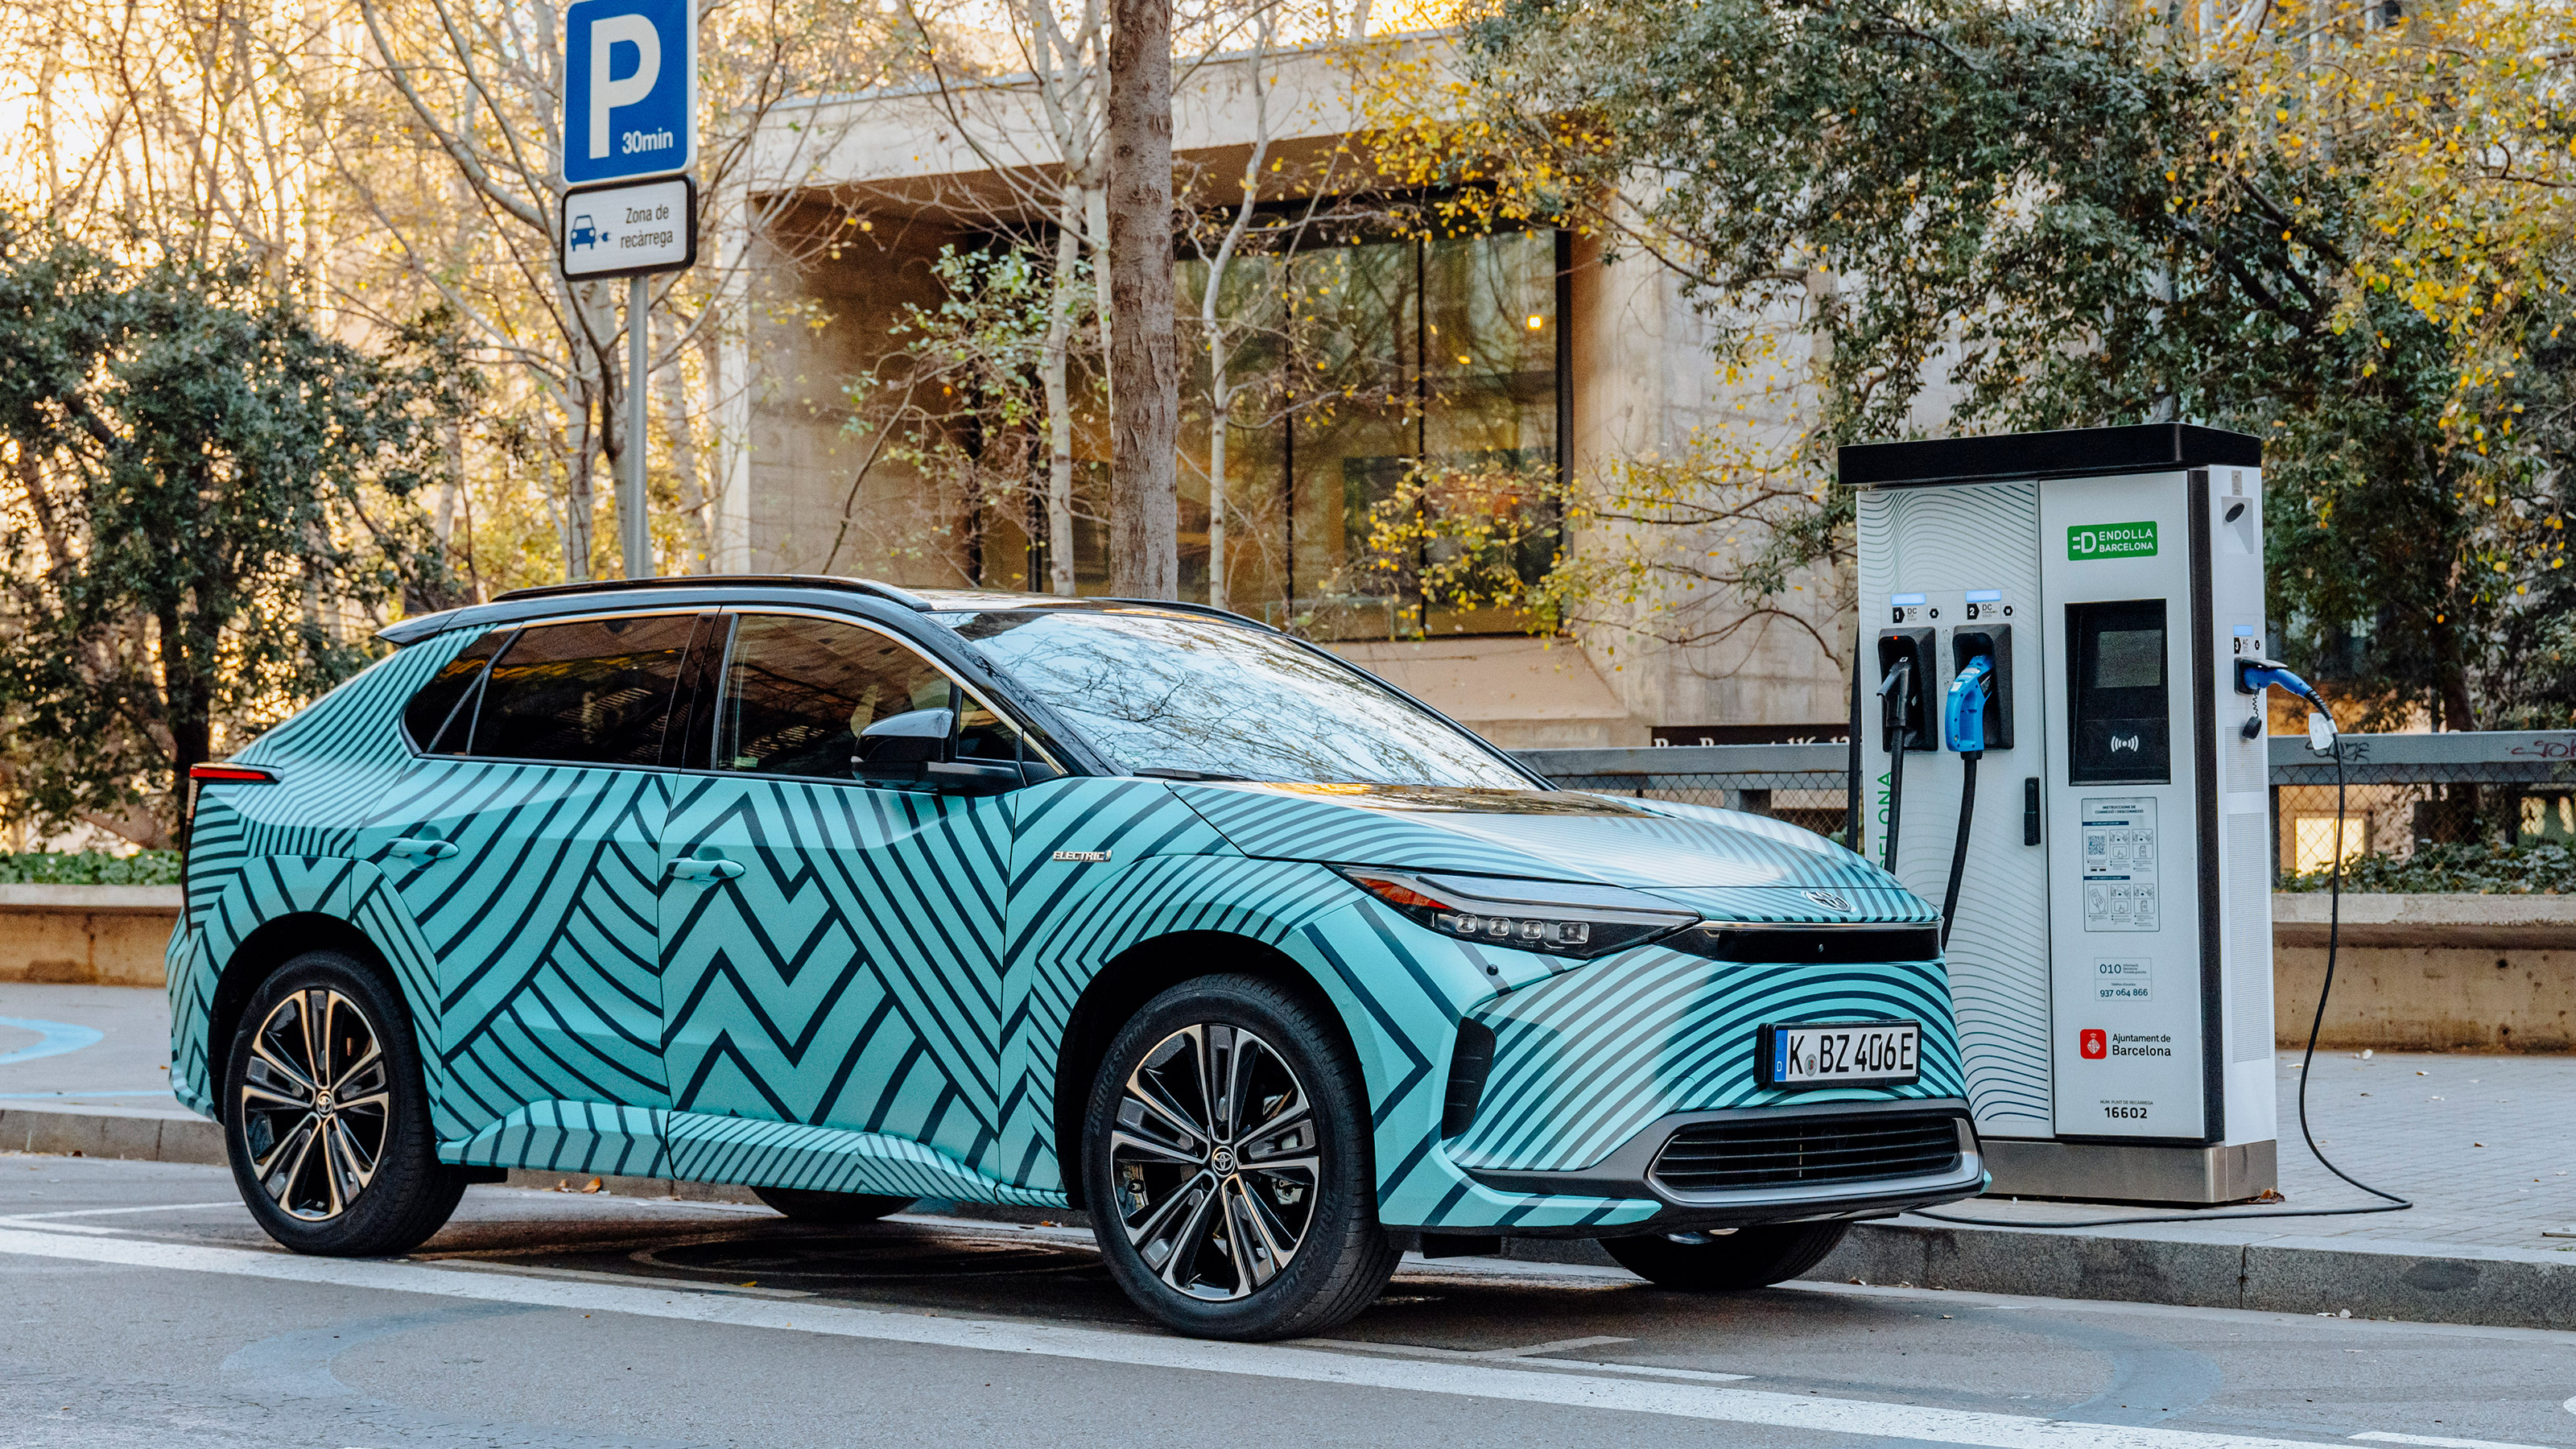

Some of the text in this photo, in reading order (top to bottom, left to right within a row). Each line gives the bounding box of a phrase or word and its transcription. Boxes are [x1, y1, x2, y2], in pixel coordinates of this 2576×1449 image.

[589, 14, 661, 159] P
[622, 127, 673, 154] 30min
[626, 204, 669, 224] Zona de
[621, 232, 673, 250] recàrrega
[2099, 528, 2153, 541] ENDOLLA
[2099, 542, 2153, 552] BARCELONA
[1895, 611, 1900, 620] 1
[1969, 607, 1975, 616] 2
[1053, 850, 1105, 861] ELECTRIC
[2099, 964, 2121, 973] 010
[2116, 989, 2131, 997] 064
[2112, 1034, 2171, 1043] Ajuntament de
[1789, 1035, 1805, 1074] K
[1819, 1034, 1850, 1073] BZ
[2112, 1045, 2171, 1056] Barcelona
[1777, 1061, 1782, 1071] D
[2104, 1107, 2147, 1119] 16602
